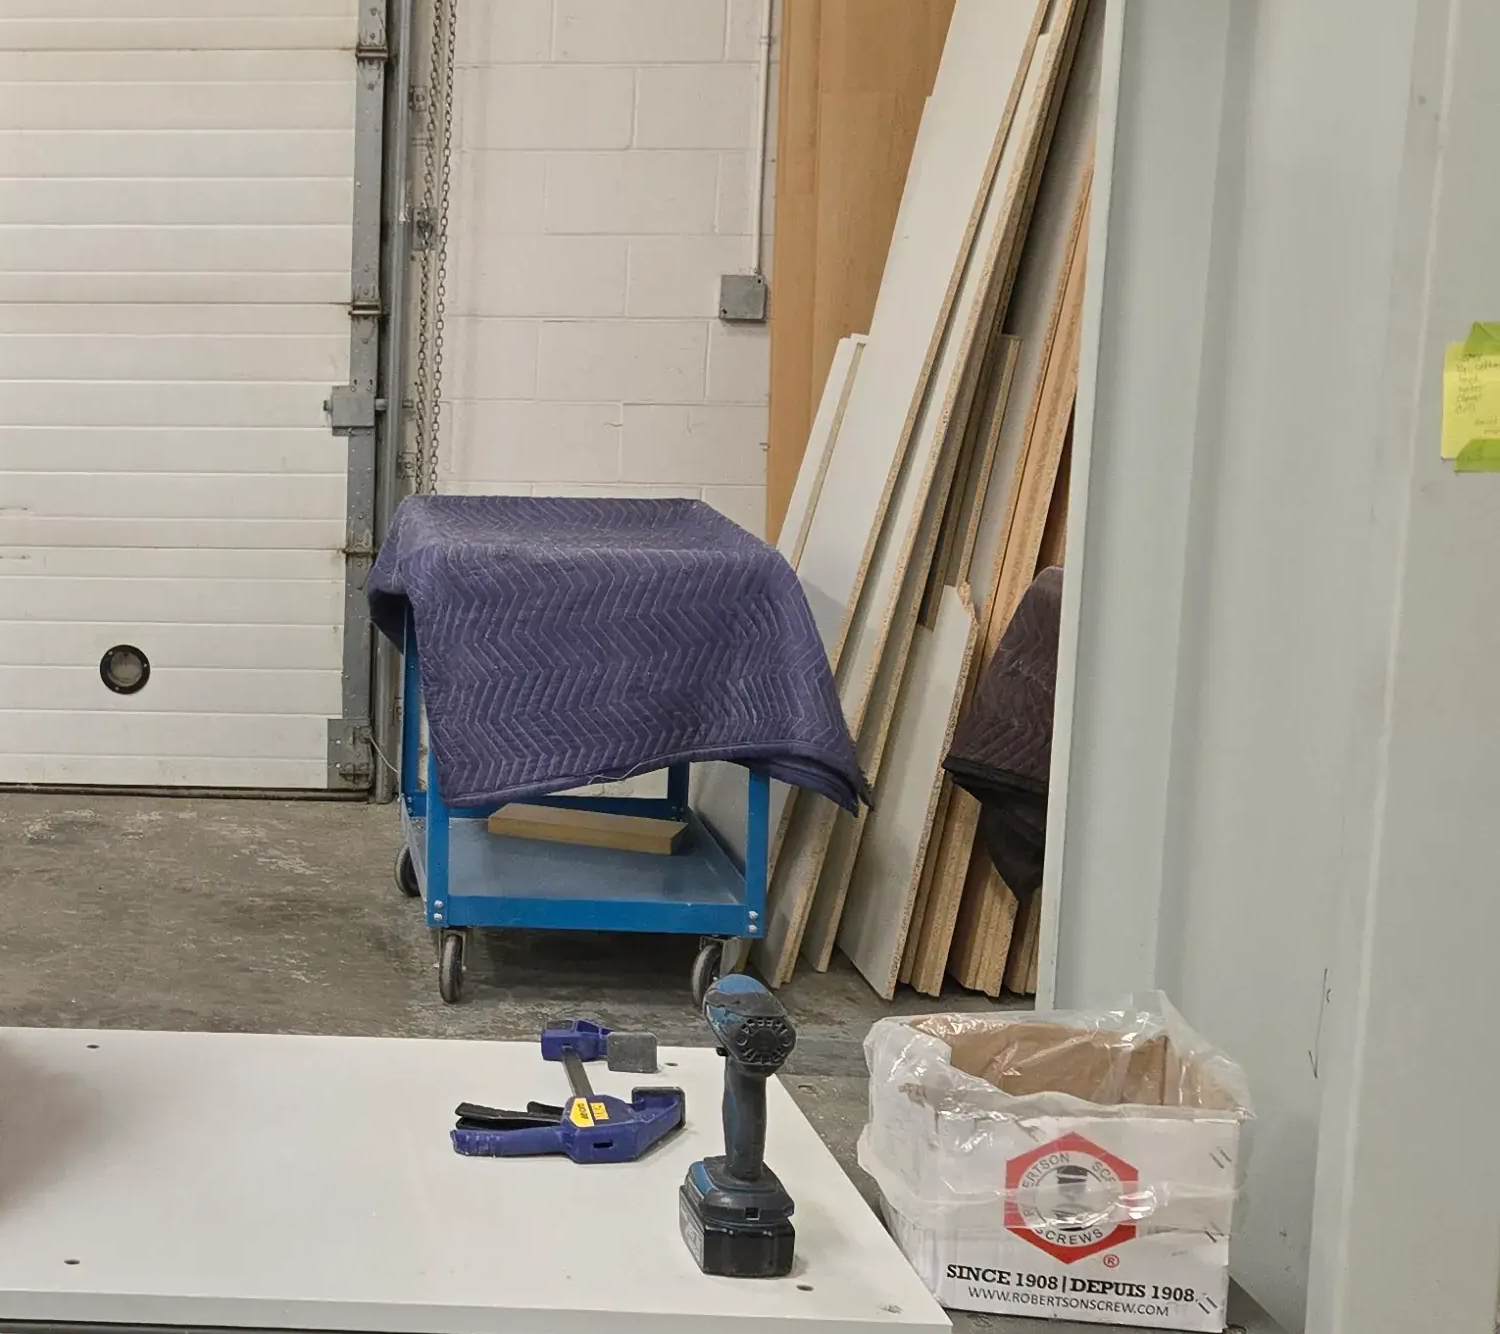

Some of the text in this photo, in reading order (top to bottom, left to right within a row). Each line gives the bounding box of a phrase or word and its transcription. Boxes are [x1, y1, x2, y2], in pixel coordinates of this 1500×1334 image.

[946, 1263, 1012, 1287] SINCE
[1069, 1277, 1147, 1299] DEPUIS
[1151, 1284, 1196, 1303] 1908
[967, 1285, 1170, 1317] WWW.ROBERTSONSCREW.COM
